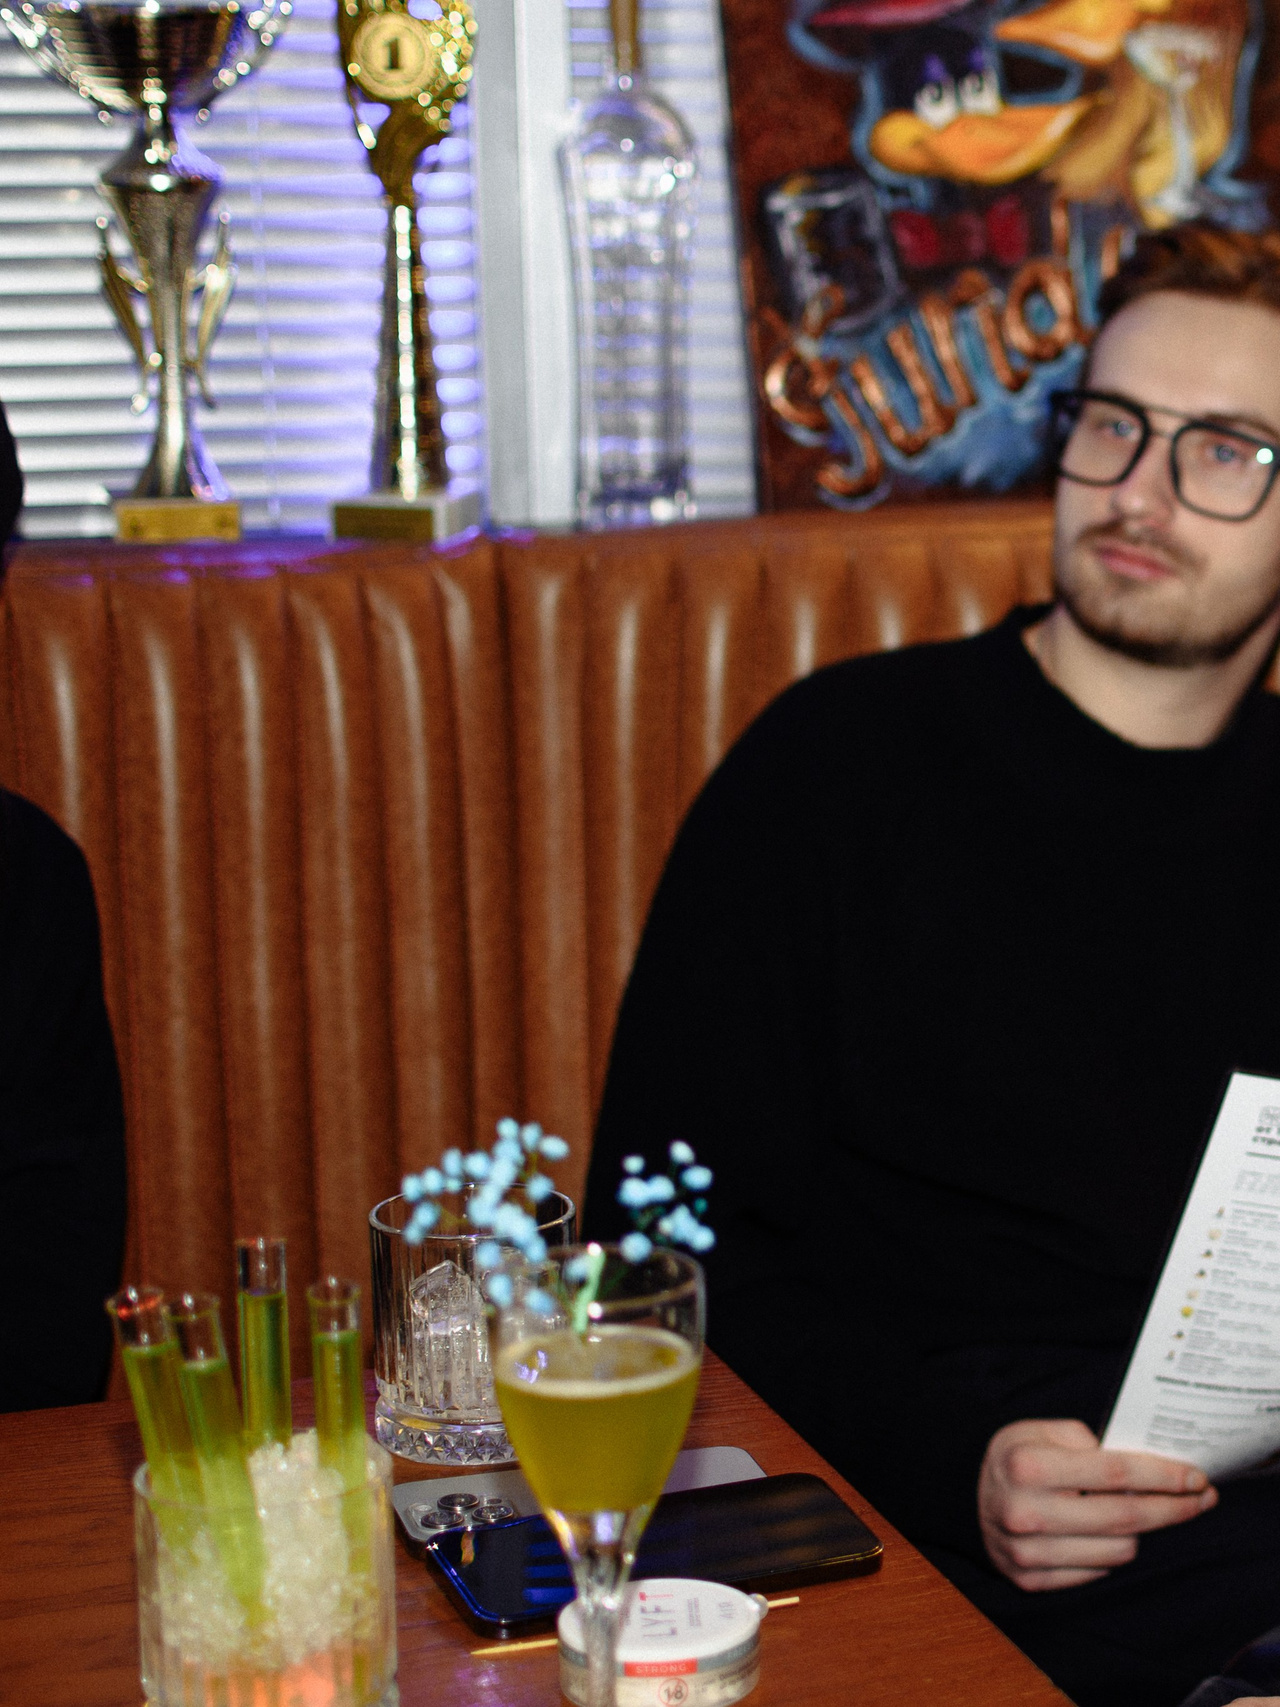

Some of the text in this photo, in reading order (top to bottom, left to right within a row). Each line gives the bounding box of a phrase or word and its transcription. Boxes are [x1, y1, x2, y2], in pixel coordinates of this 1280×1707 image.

[383, 37, 405, 70] 1
[639, 1591, 677, 1638] LYFT
[635, 1662, 688, 1675] STRONG
